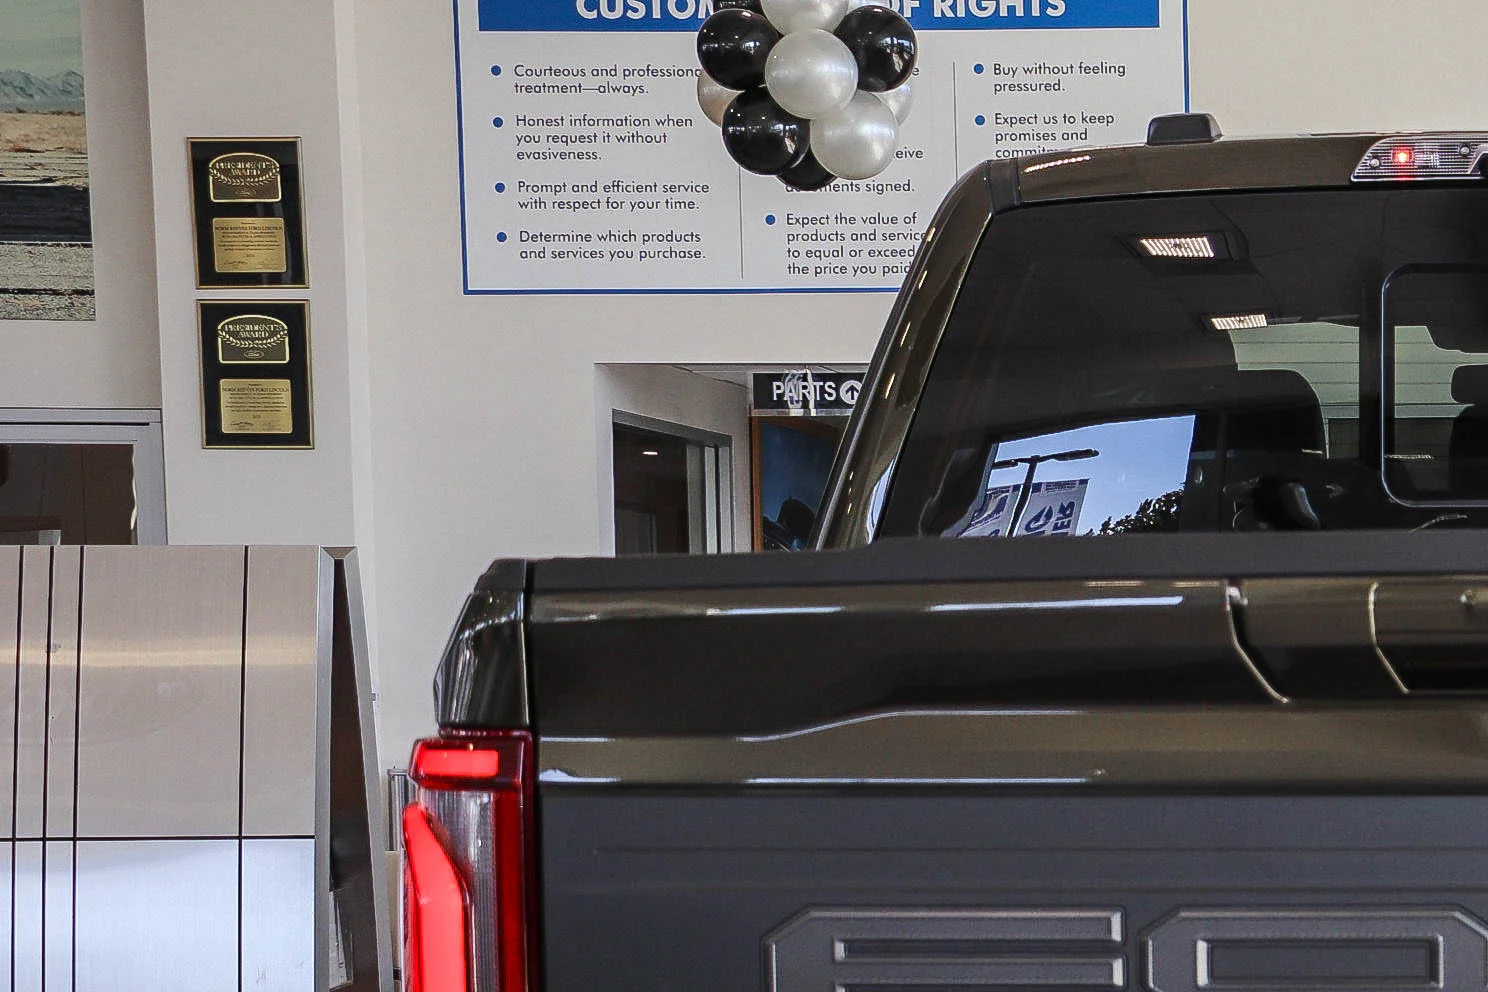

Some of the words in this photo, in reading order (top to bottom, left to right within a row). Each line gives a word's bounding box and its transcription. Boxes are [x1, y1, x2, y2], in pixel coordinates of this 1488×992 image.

[576, 0, 713, 20] CUSTO
[933, 0, 1066, 18] RIGHTS
[514, 65, 586, 77] Courteous
[591, 64, 617, 77] and
[623, 64, 702, 81] professiona
[993, 63, 1018, 78] Buy
[1022, 62, 1074, 75] without
[1078, 61, 1126, 78] feeling
[994, 78, 1066, 95] pressured.
[515, 115, 564, 127] Honest
[570, 114, 650, 127] information
[655, 115, 693, 127] when
[994, 112, 1038, 128] Expect
[1043, 114, 1058, 125] us
[1062, 113, 1077, 125] to
[1081, 111, 1115, 128] keep
[516, 134, 541, 145] you
[546, 132, 598, 145] request
[603, 131, 611, 143] it
[615, 131, 667, 144] without
[995, 128, 1057, 144] promises
[1061, 128, 1087, 141] and
[517, 148, 602, 160] evasiveness.
[895, 147, 924, 159] eive
[518, 181, 567, 196] Prompt
[572, 180, 598, 193] and
[603, 180, 658, 193] efficient
[663, 181, 709, 193] service
[865, 179, 915, 195] signed.
[518, 197, 547, 209] with
[552, 198, 601, 212] respect
[606, 197, 625, 209] for
[630, 200, 661, 212] your
[665, 197, 700, 209] time.
[786, 213, 830, 228] Expect
[835, 213, 857, 225] the
[861, 213, 898, 225] value
[903, 212, 917, 225] of
[519, 230, 592, 243] Determine
[596, 230, 637, 243] which
[642, 230, 701, 246] products
[787, 229, 846, 245] products
[850, 229, 877, 242] and
[881, 229, 927, 242] service
[519, 247, 546, 259] and
[551, 247, 604, 259] services
[609, 249, 634, 263] you
[639, 247, 706, 262] purchase.
[787, 247, 800, 259] to
[805, 245, 844, 261] equal
[848, 249, 864, 259] or
[868, 244, 915, 258] exceed
[787, 262, 810, 275] the
[814, 262, 848, 278] price
[852, 265, 877, 277] you
[772, 381, 836, 401] PARTS
